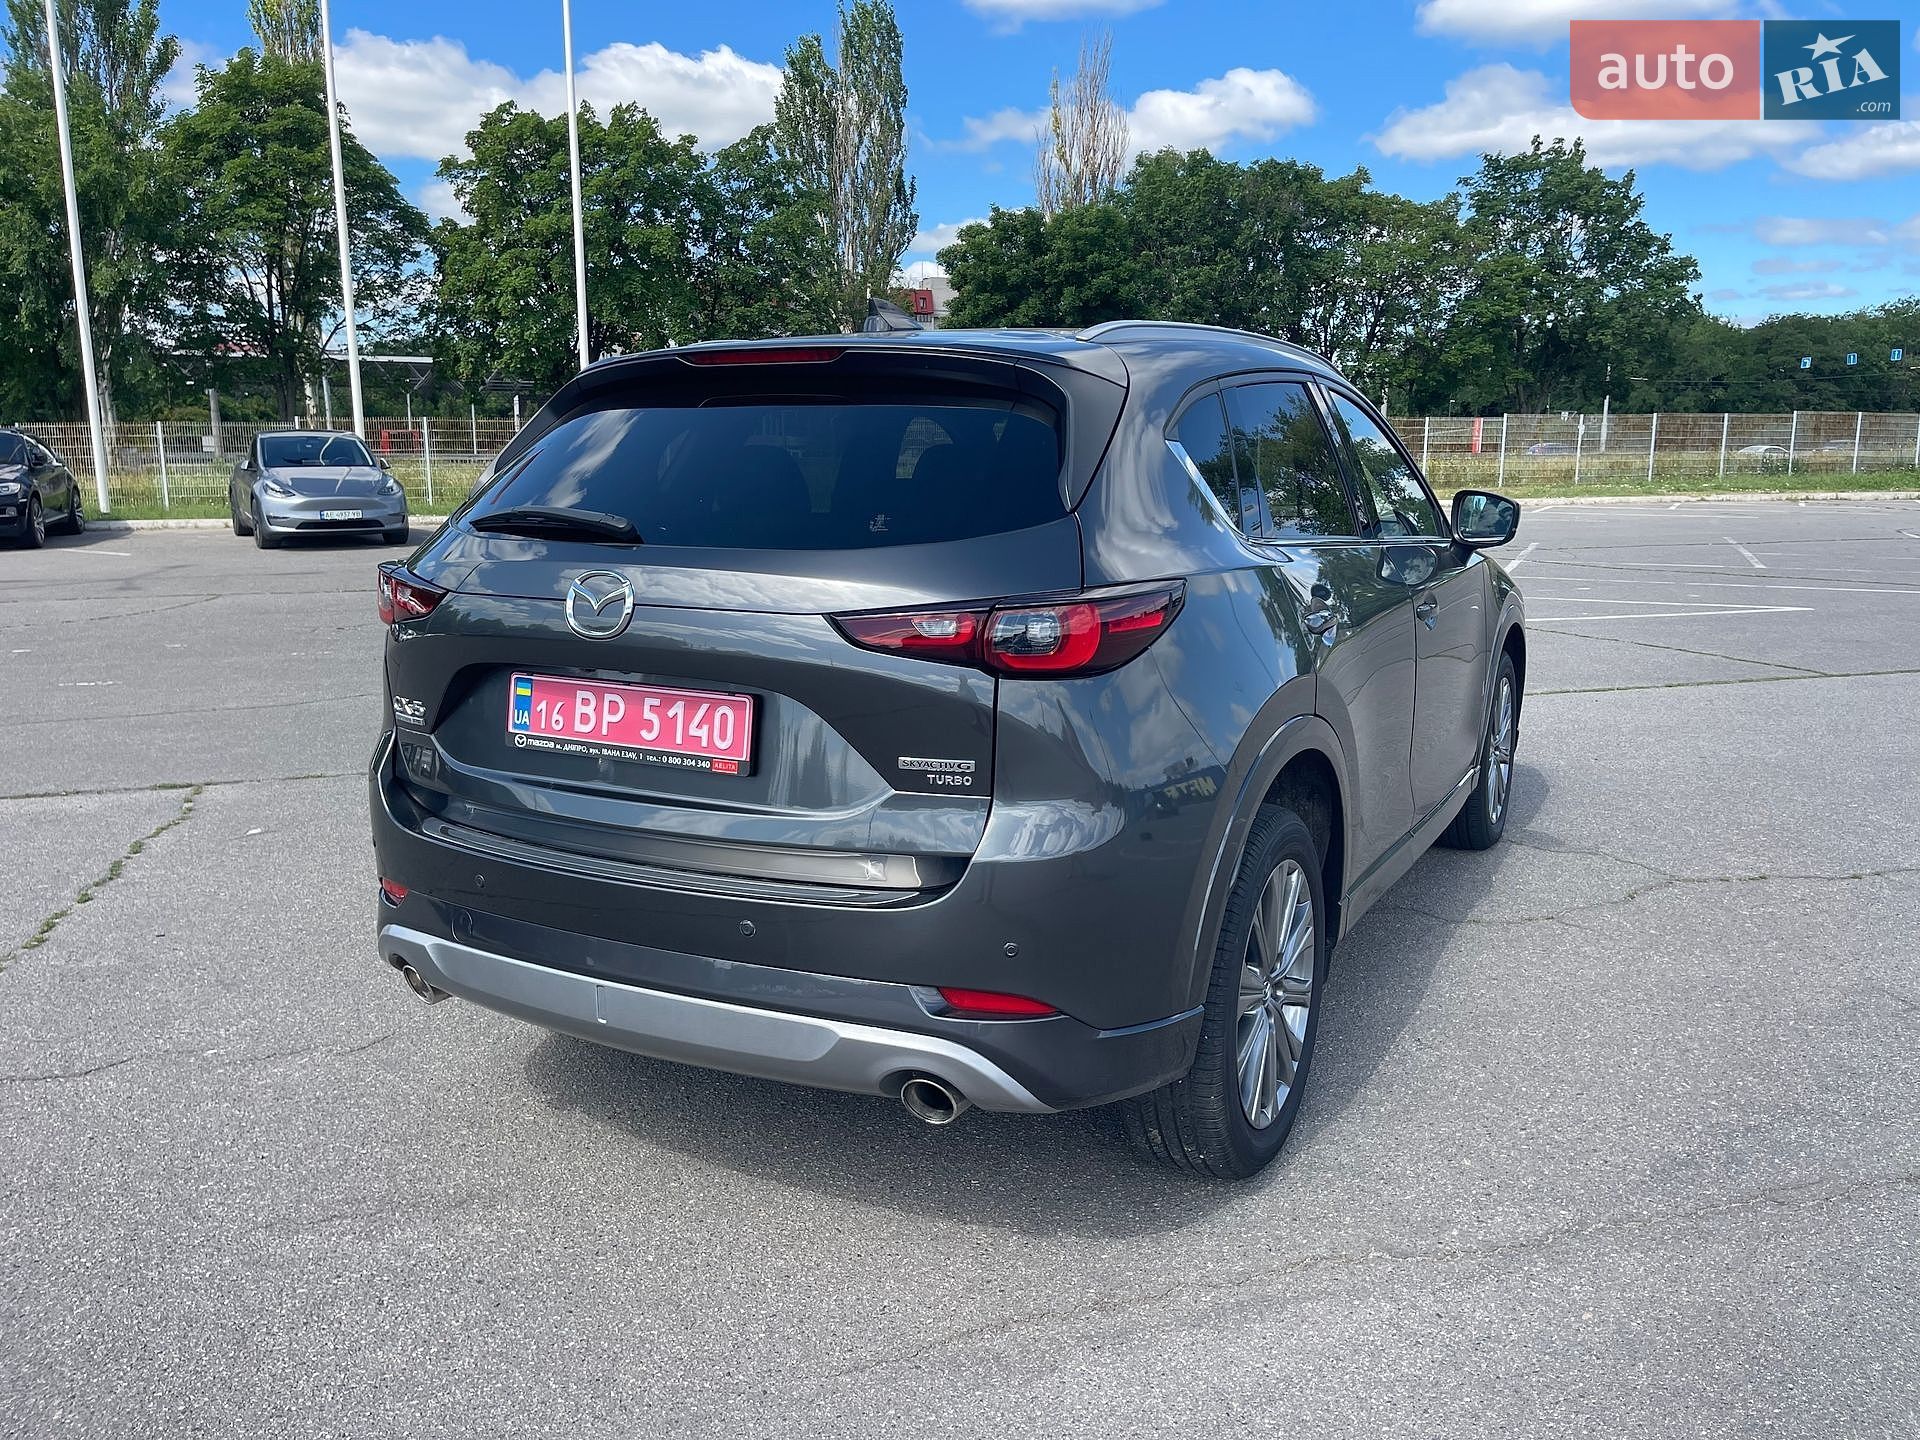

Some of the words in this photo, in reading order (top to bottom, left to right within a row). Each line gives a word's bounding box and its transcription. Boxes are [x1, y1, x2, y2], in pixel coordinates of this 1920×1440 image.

[514, 709, 530, 725] UA
[536, 700, 565, 731] 16
[574, 690, 626, 736] BP
[640, 697, 735, 750] 5140
[527, 738, 555, 749] mazda
[662, 755, 667, 763] 0
[668, 756, 682, 765] 800
[683, 758, 696, 767] 304
[696, 760, 711, 769] 340
[926, 774, 973, 786] TURBO
